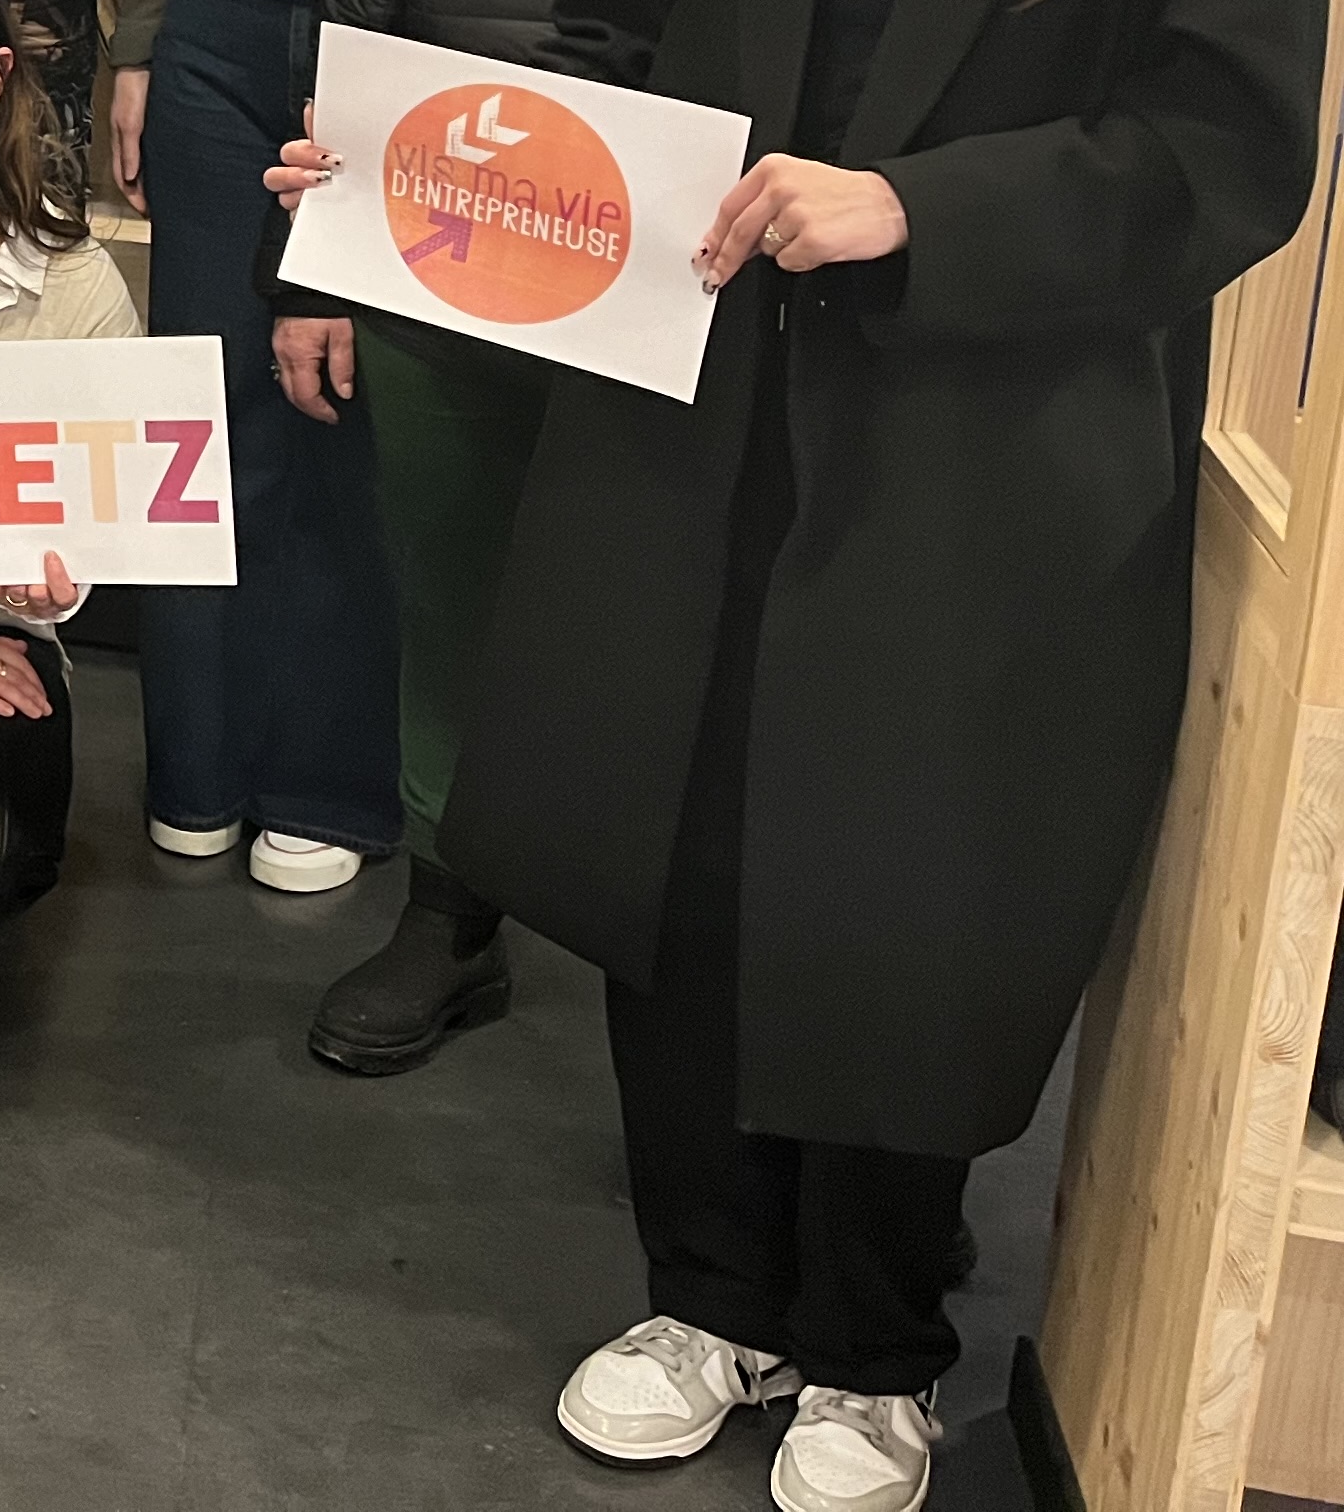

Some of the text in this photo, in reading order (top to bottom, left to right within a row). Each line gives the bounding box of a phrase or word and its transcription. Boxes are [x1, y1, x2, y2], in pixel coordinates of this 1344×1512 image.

[390, 168, 620, 263] D'ENTREPRENEUSE
[393, 141, 622, 230] vis ma vie
